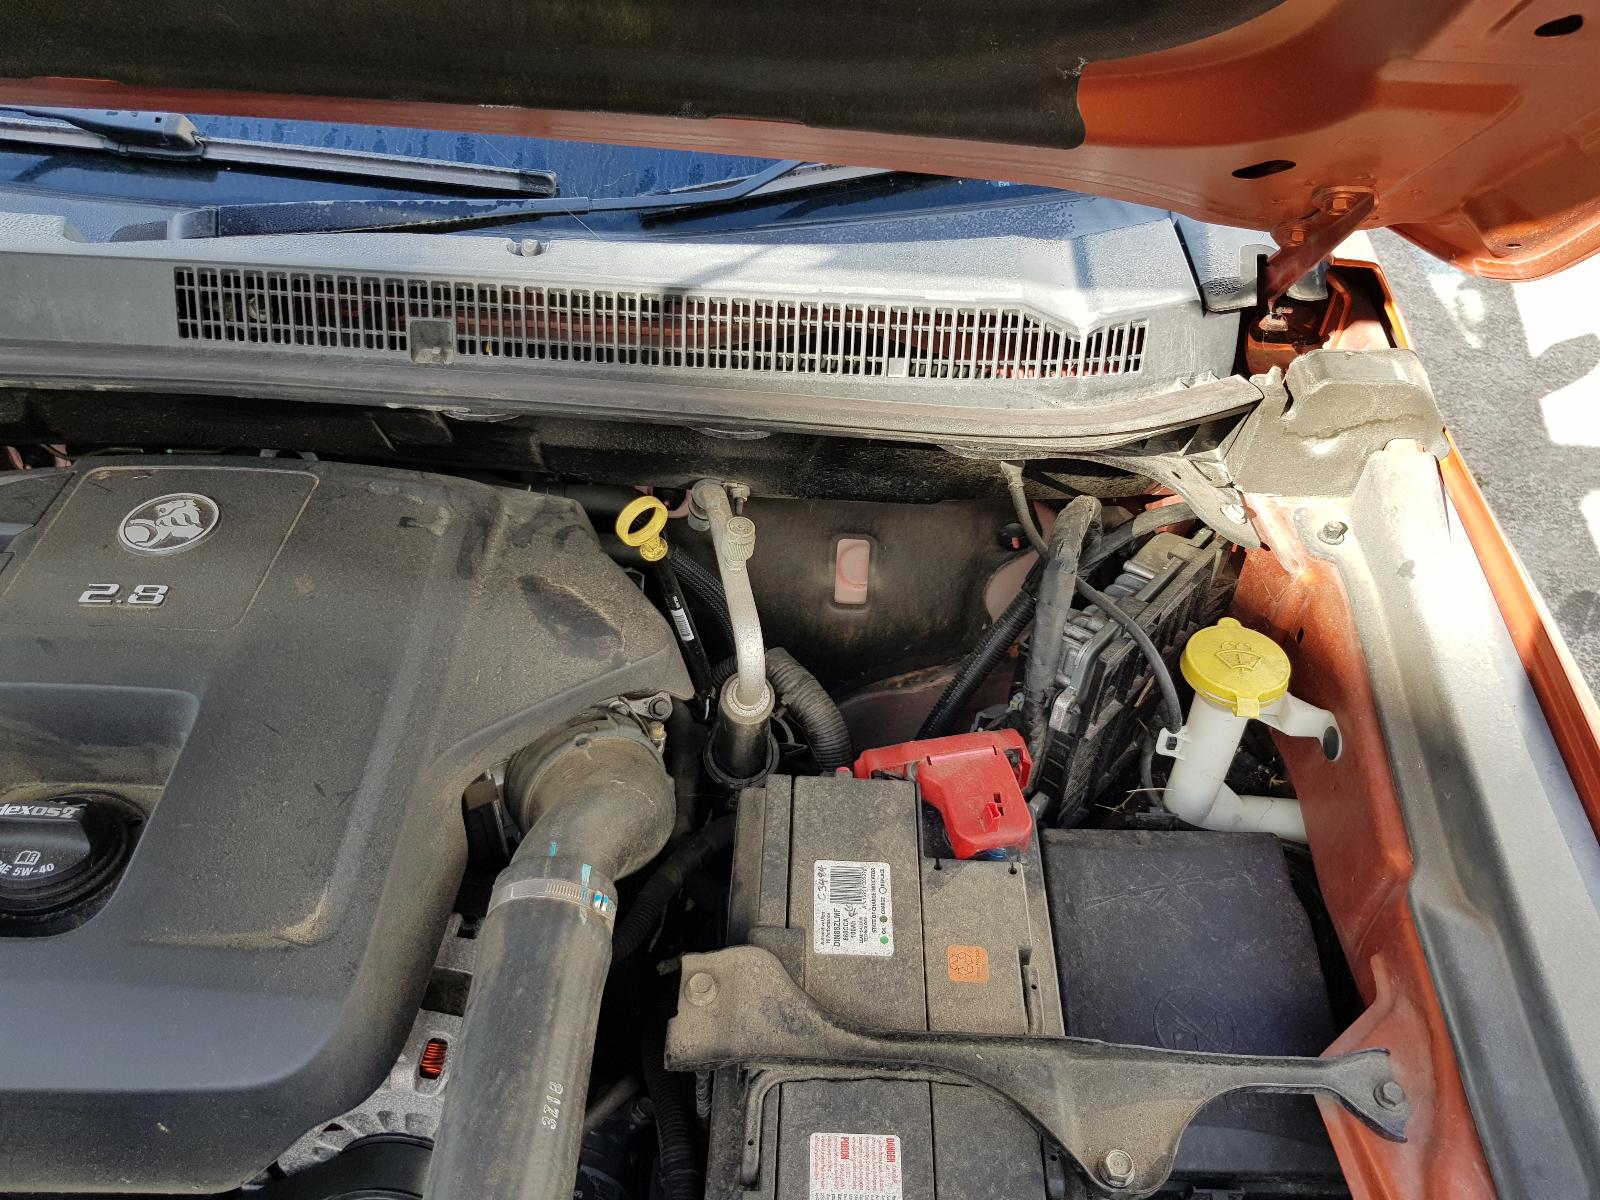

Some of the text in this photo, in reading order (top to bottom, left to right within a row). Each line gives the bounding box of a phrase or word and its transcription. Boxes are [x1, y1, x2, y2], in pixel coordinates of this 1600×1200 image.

[79, 583, 169, 605] 2.8
[0, 861, 54, 876] AE 5W-40
[833, 908, 841, 947] DIN88ZLMF
[841, 1137, 849, 1160] POISON
[886, 1138, 896, 1163] DANGER
